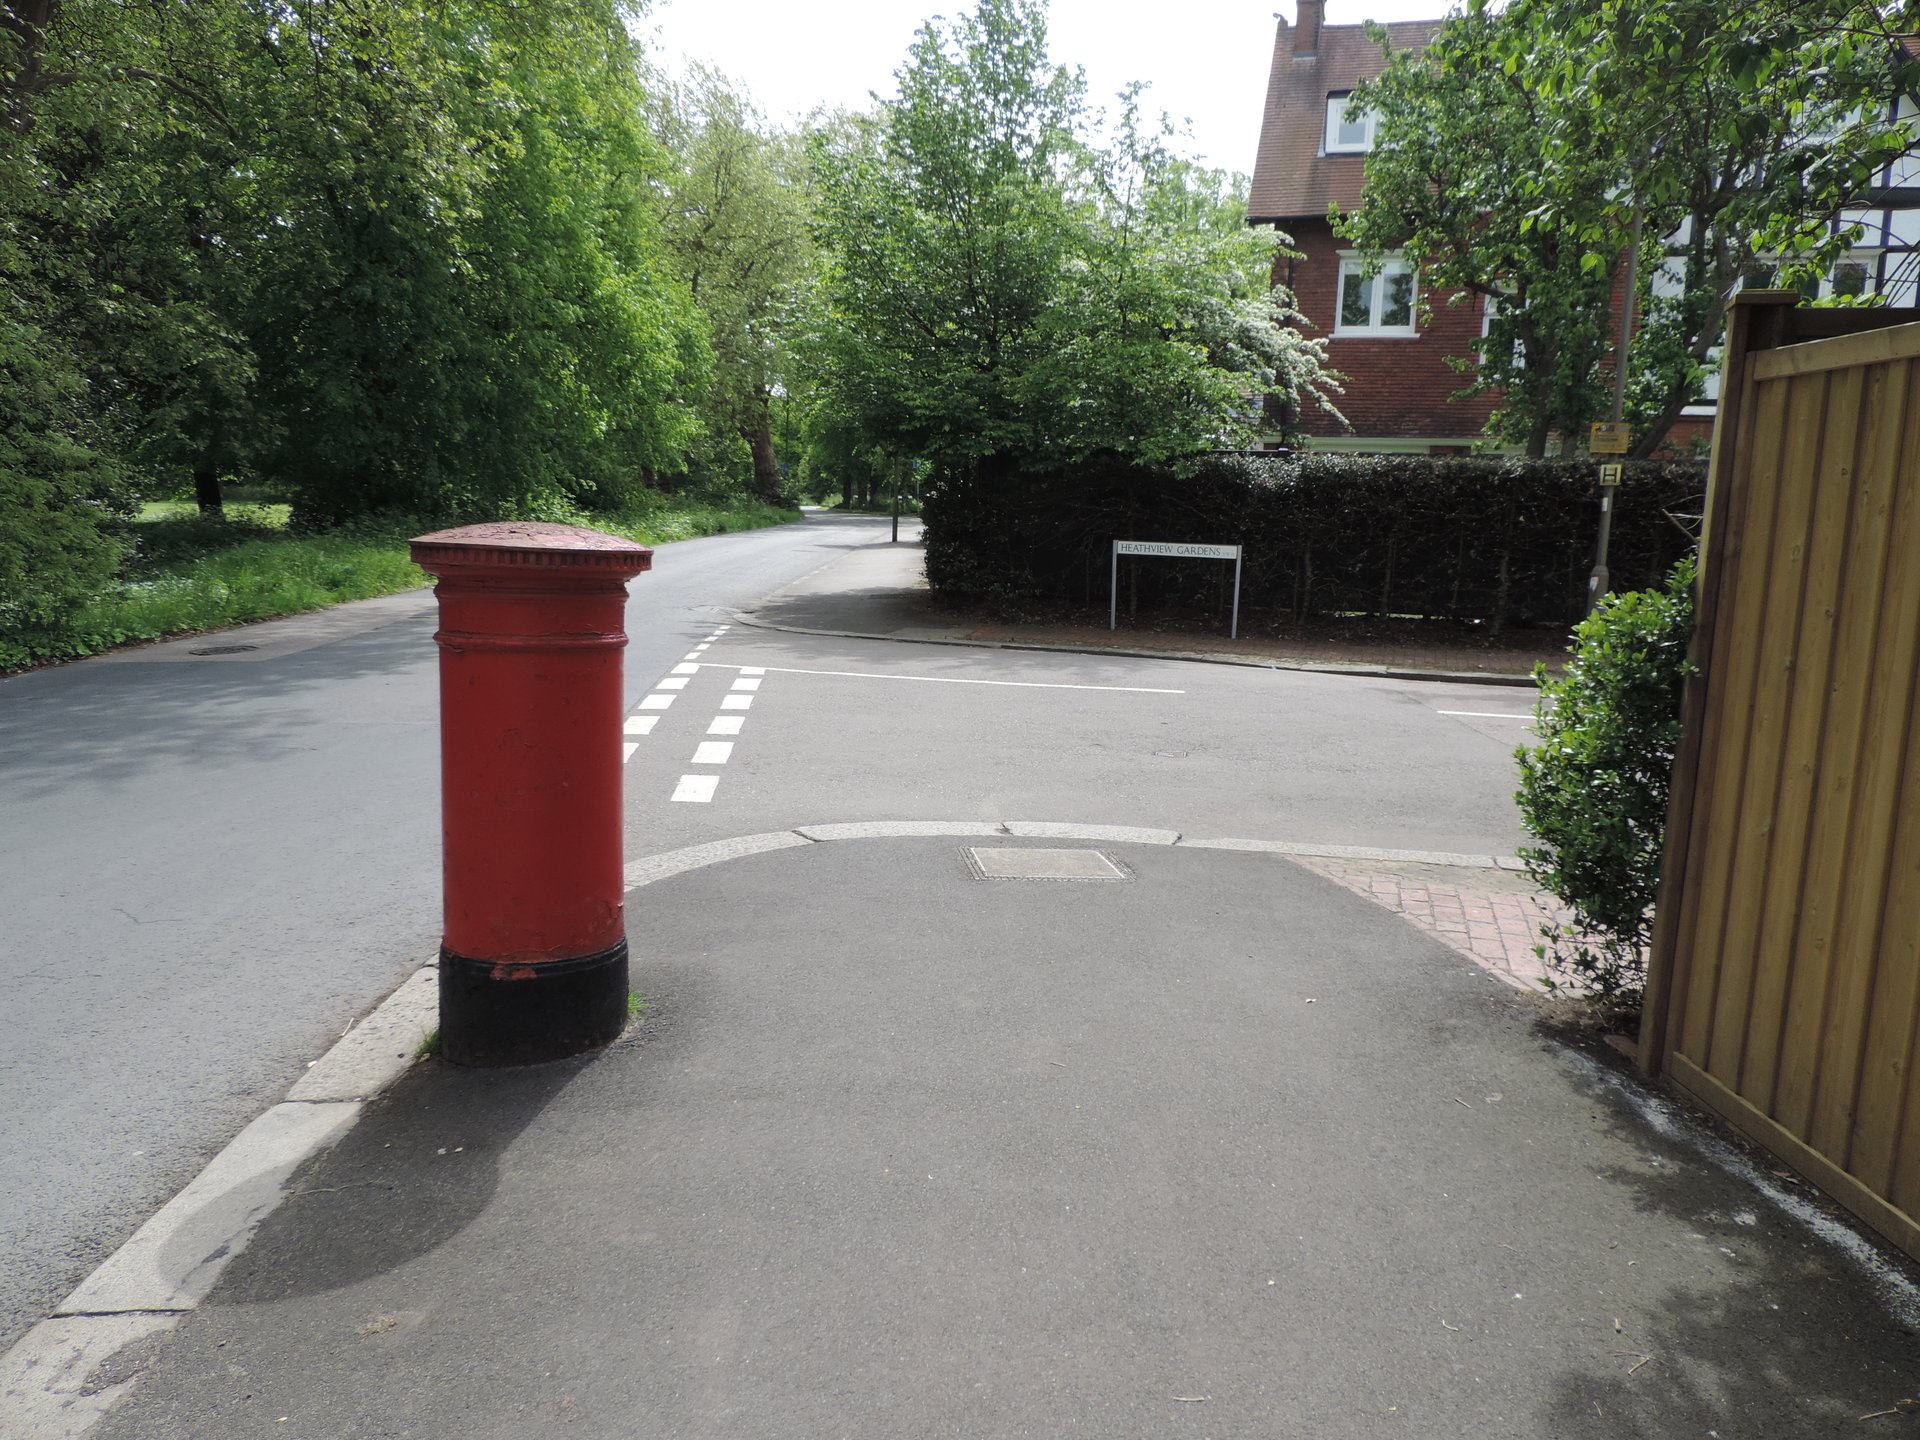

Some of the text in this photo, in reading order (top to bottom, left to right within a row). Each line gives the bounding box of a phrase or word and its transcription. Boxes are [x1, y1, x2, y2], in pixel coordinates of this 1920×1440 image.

[1602, 466, 1618, 483] H
[1121, 543, 1173, 554] HEATHVIEW
[1176, 546, 1221, 556] GARDENS
